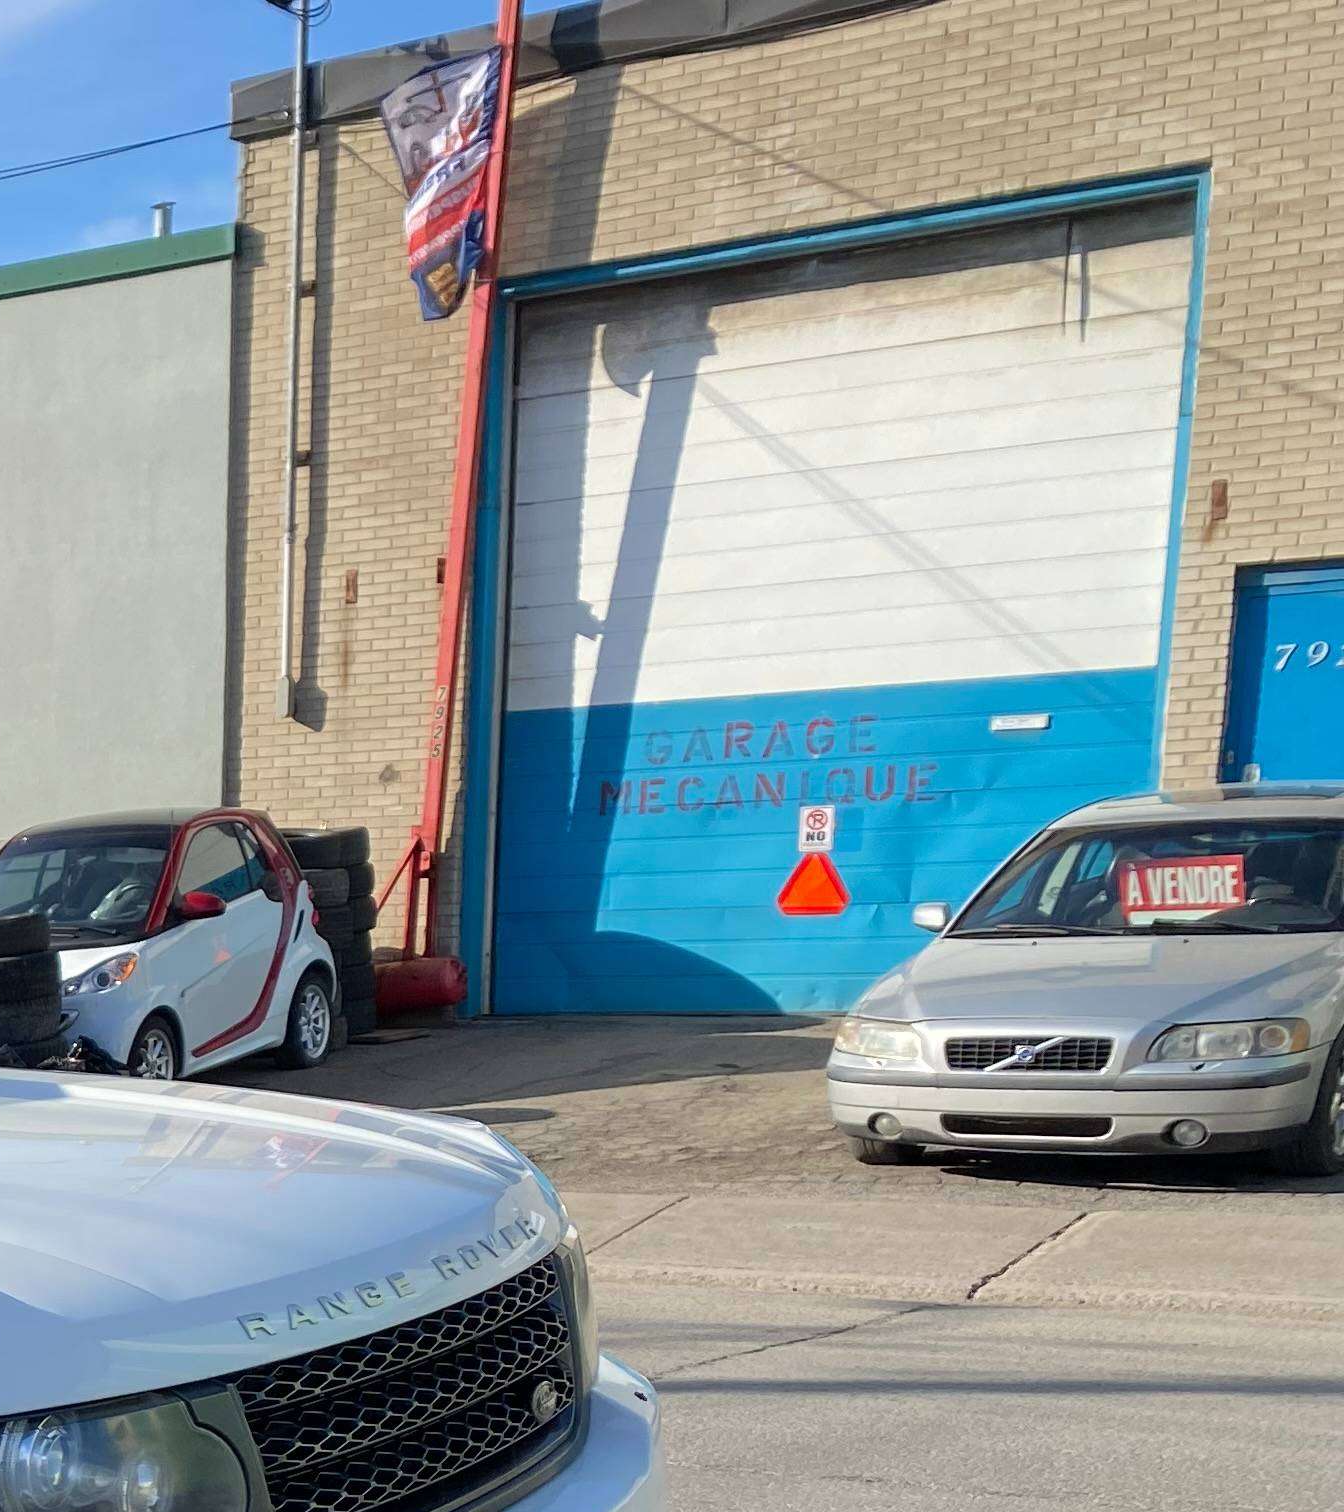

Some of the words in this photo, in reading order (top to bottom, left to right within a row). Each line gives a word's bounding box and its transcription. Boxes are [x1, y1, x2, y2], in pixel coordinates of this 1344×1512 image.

[645, 713, 879, 766] GARAGE
[598, 762, 939, 817] MECANIQUE
[806, 831, 826, 842] NO
[1146, 864, 1241, 906] VENDRE
[237, 1270, 417, 1340] RANGE
[430, 1214, 538, 1281] ROVER
